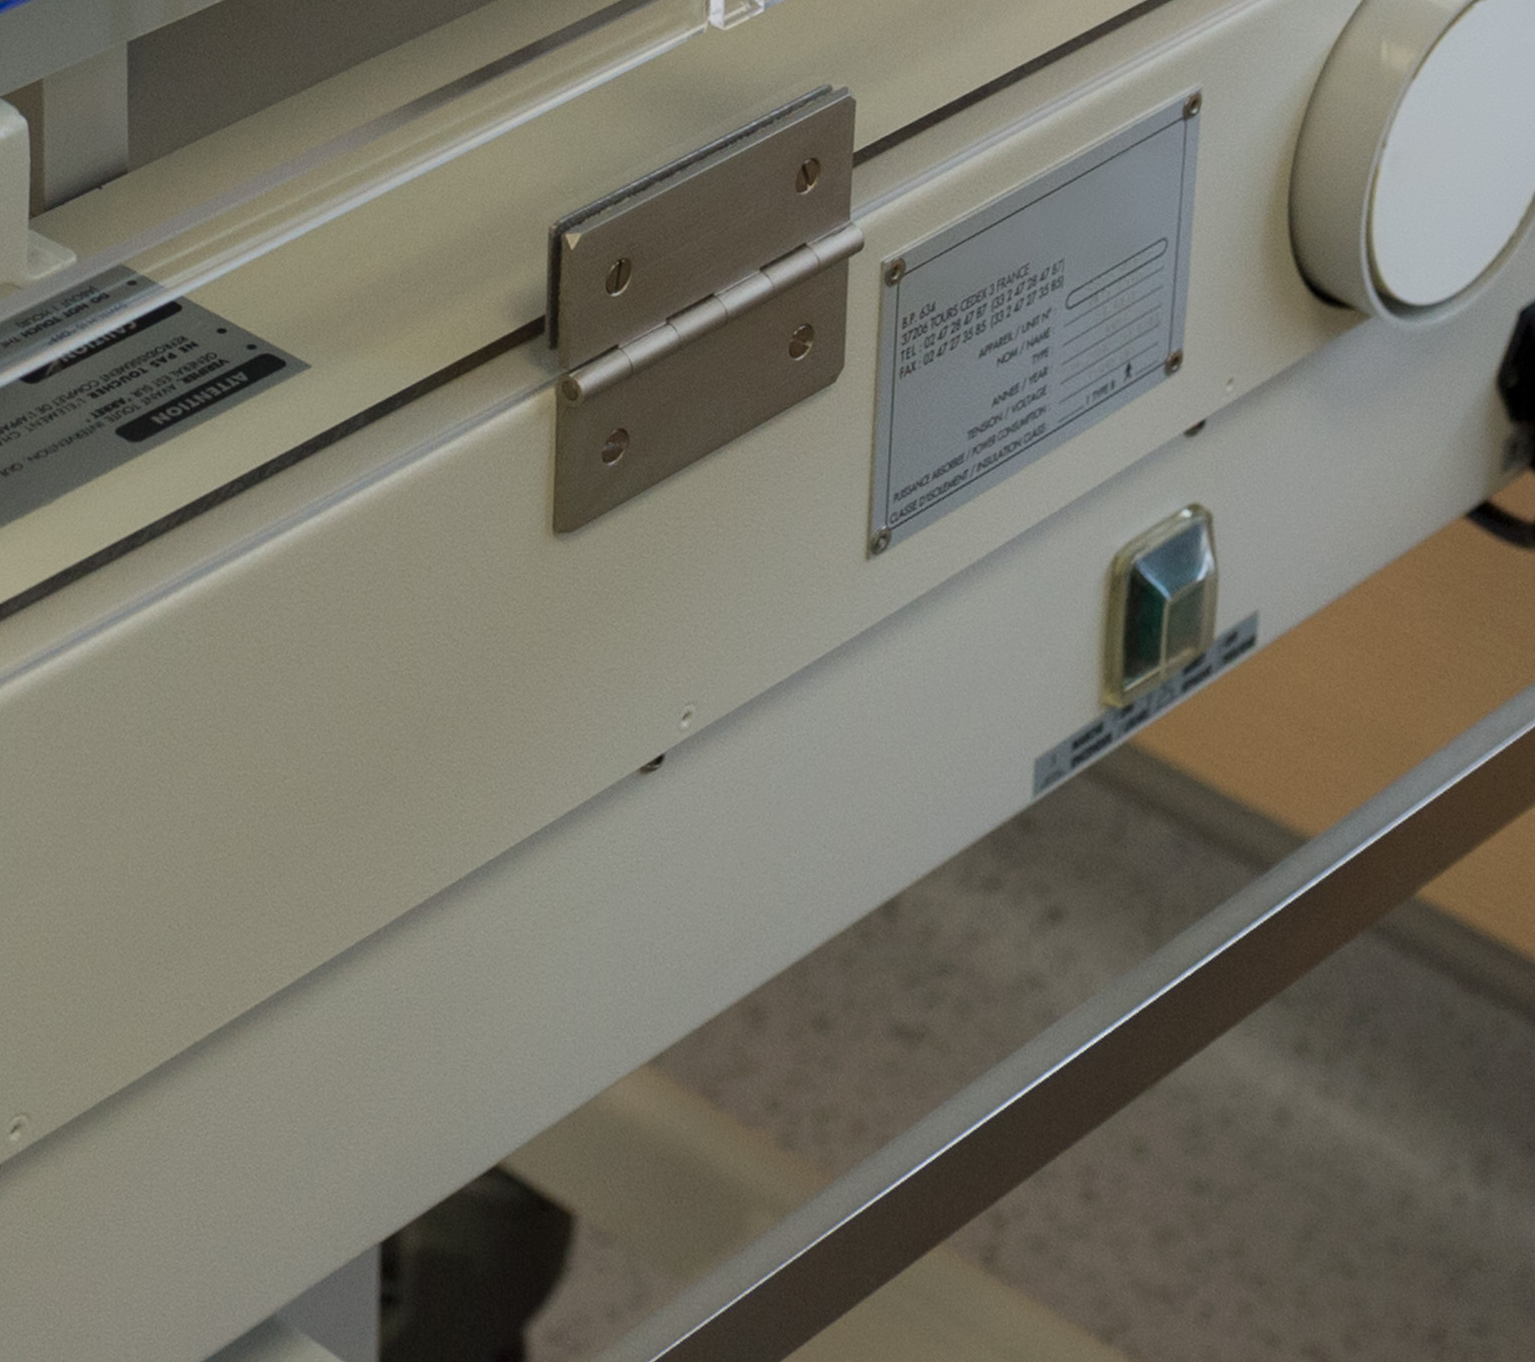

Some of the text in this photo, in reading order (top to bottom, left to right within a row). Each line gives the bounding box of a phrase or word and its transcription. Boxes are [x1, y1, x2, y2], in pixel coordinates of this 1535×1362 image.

[58, 301, 91, 319] NOT
[86, 291, 112, 305] DO
[901, 260, 1030, 347] 37206 TOURS CEDEX 3 FRANCE
[17, 315, 63, 339] TOUCH
[900, 342, 916, 364] TEL
[924, 332, 935, 350] 02
[937, 324, 948, 342] 47
[950, 317, 961, 335] 28
[963, 308, 975, 327] 47
[1006, 287, 1012, 302] 2
[1014, 280, 1025, 298] 47
[1026, 273, 1037, 291] 28
[1039, 265, 1050, 282] 47
[901, 298, 936, 330] B.P. 634
[899, 358, 916, 380] FAX
[923, 348, 934, 366] 02
[936, 340, 947, 359] 47
[949, 333, 960, 351] 27
[962, 325, 974, 344] 35
[1006, 303, 1011, 318] 2
[1013, 295, 1024, 314] 47
[1025, 288, 1037, 307] 27
[1038, 281, 1049, 300] 35
[977, 329, 1014, 360] APPAREIL
[1021, 314, 1039, 335] UNIT
[95, 333, 189, 382] REFROIDISSEMENT
[146, 351, 178, 368] PAS
[174, 340, 201, 354] NE
[996, 325, 1050, 368] NOM NAME
[1031, 344, 1049, 366] TYPE
[166, 350, 220, 378] GENERAL
[1028, 364, 1048, 386] YEAR
[48, 378, 102, 406] COMPLET
[84, 365, 150, 400] TOUCHER
[127, 383, 155, 398] SUR
[136, 382, 181, 405] AVANT
[148, 374, 173, 387] EST
[31, 402, 55, 415] DE
[147, 370, 252, 425] ATTENTION
[101, 402, 141, 423] TOUTE
[967, 383, 1047, 441] TENSION VOLTAGE
[889, 498, 917, 525] CLASSE
[918, 467, 969, 508] D'ISOLEMENT
[976, 436, 1022, 473] INSULATION
[1023, 421, 1046, 444] CLASS
[1091, 382, 1108, 402] TYPE
[893, 472, 929, 504] PUISSANCE
[971, 433, 996, 457] POWER
[997, 402, 1047, 441] CONSUMPTION
